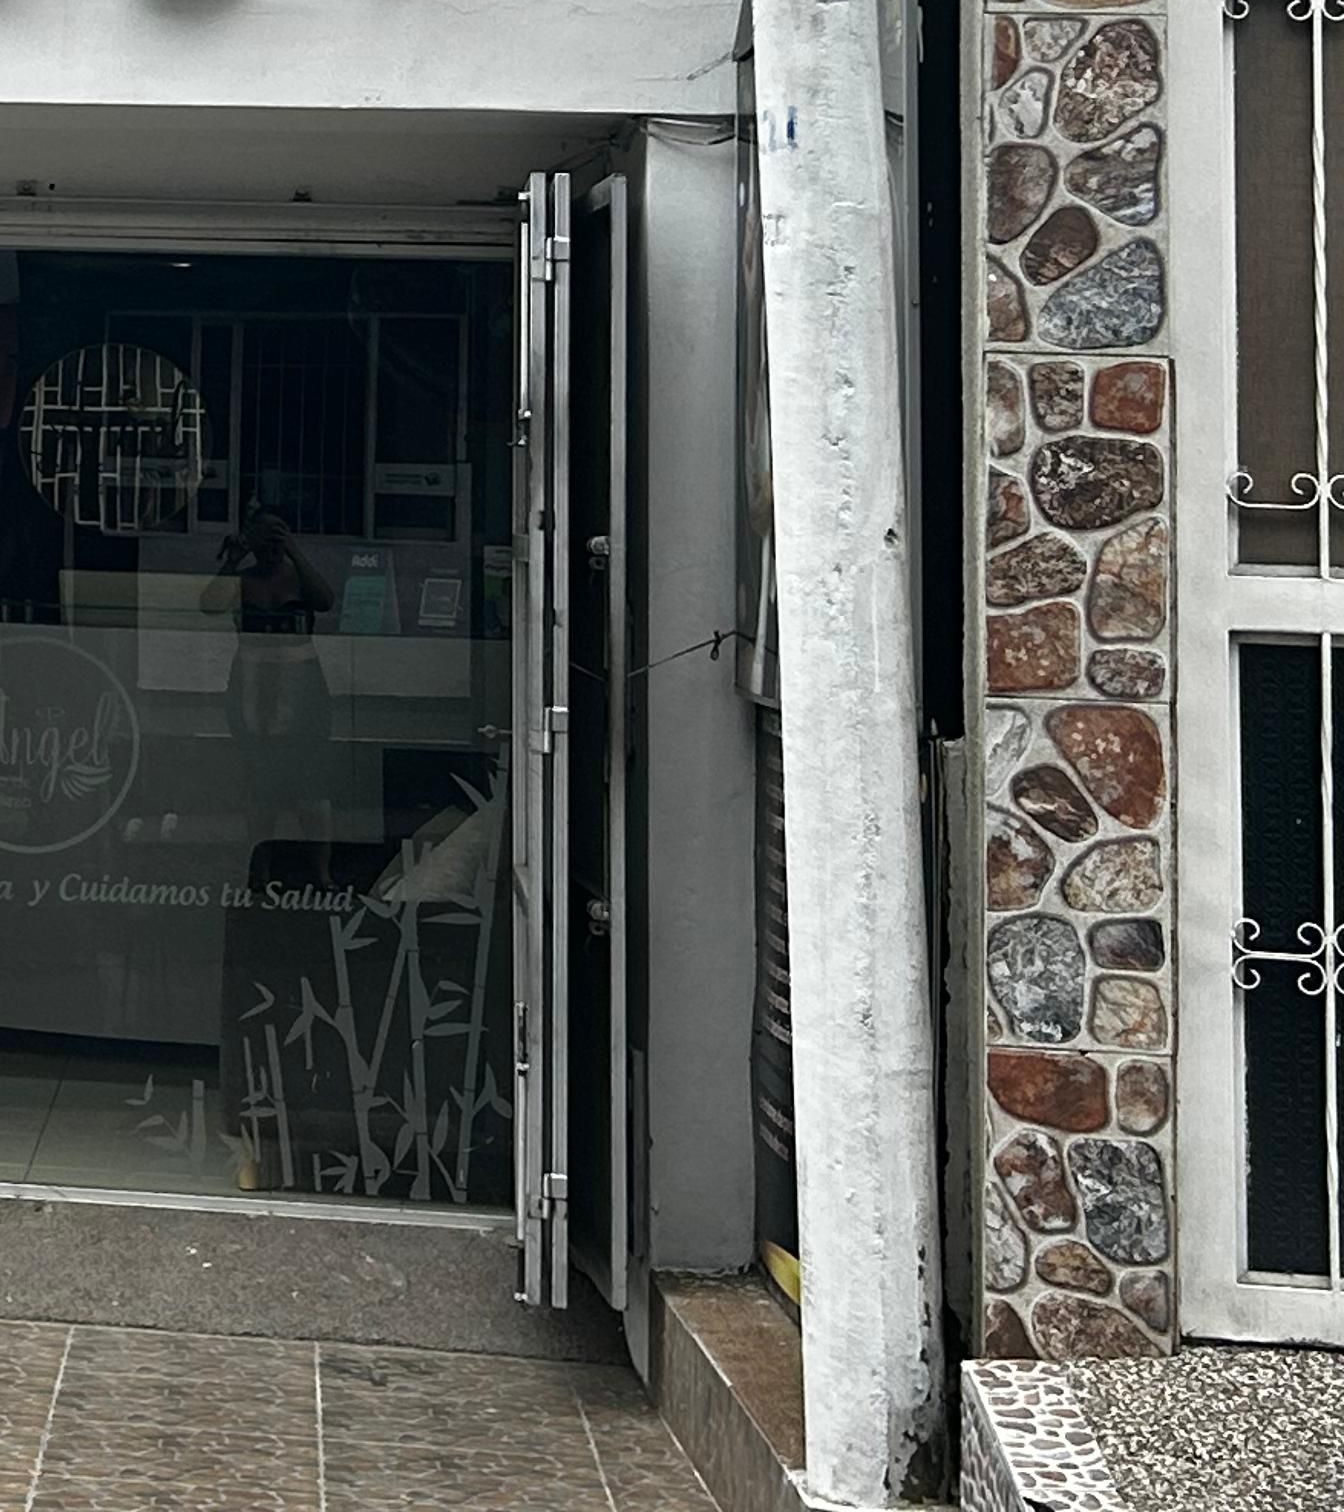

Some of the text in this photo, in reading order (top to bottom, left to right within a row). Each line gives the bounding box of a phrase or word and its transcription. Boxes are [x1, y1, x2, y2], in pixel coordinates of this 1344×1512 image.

[27, 879, 50, 909] y
[58, 874, 211, 909] Cuidamos
[220, 879, 255, 910] tu
[261, 879, 356, 915] Salud
